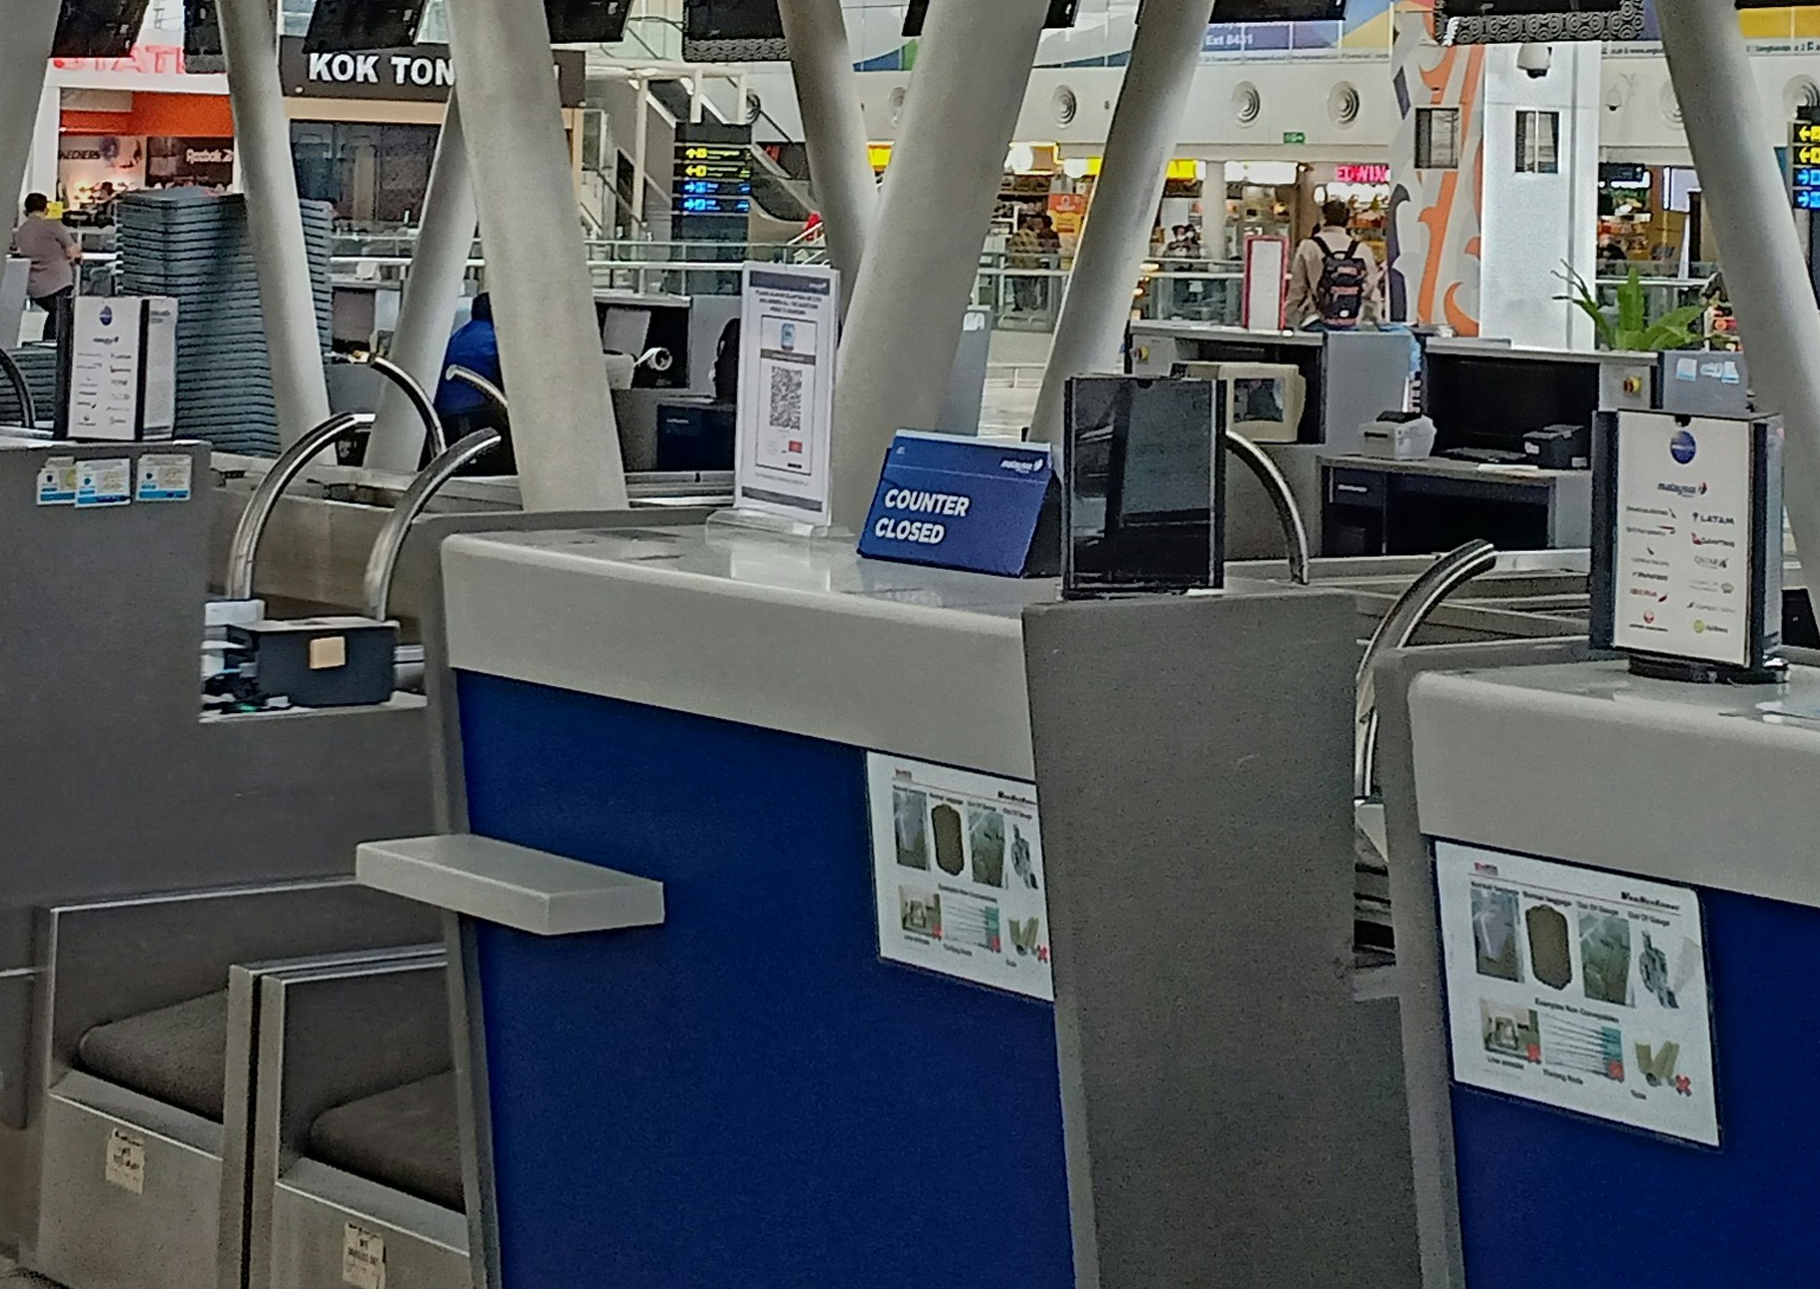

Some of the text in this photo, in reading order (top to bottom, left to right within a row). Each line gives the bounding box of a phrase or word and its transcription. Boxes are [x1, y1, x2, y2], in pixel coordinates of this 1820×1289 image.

[308, 52, 379, 83] KOK
[884, 488, 970, 517] COUNTER
[875, 517, 945, 544] CLOSED
